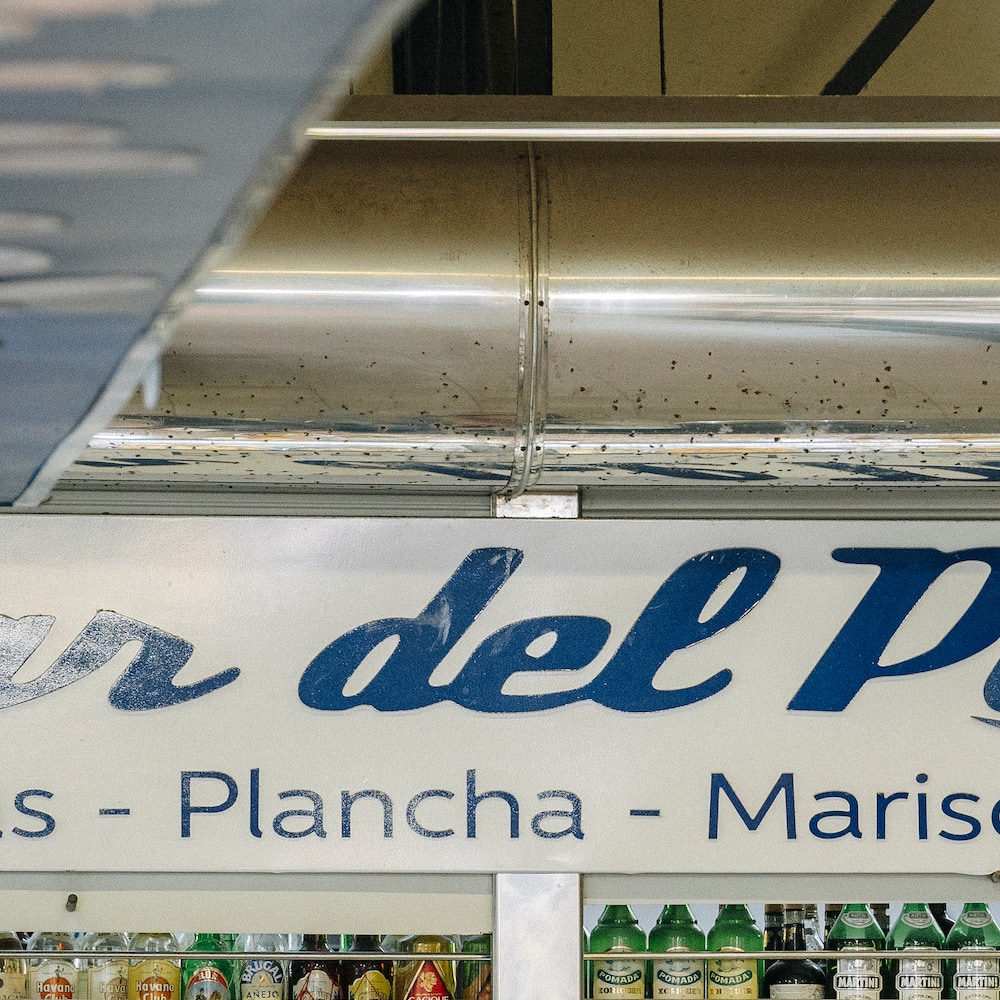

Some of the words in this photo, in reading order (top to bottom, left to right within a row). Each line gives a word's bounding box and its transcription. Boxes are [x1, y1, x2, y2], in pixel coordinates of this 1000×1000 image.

[299, 547, 781, 713] del
[180, 768, 585, 841] Plancha
[241, 959, 283, 983] BRUGAL
[599, 970, 641, 984] POMADA
[658, 970, 700, 985] POMADA
[710, 970, 752, 985] POMADA
[36, 980, 75, 993] Havana
[136, 980, 174, 993] Havana
[838, 976, 878, 988] MARTINI
[900, 976, 940, 988] MARTINI
[957, 976, 998, 988] MARTINI
[245, 988, 281, 999] AÑEJO
